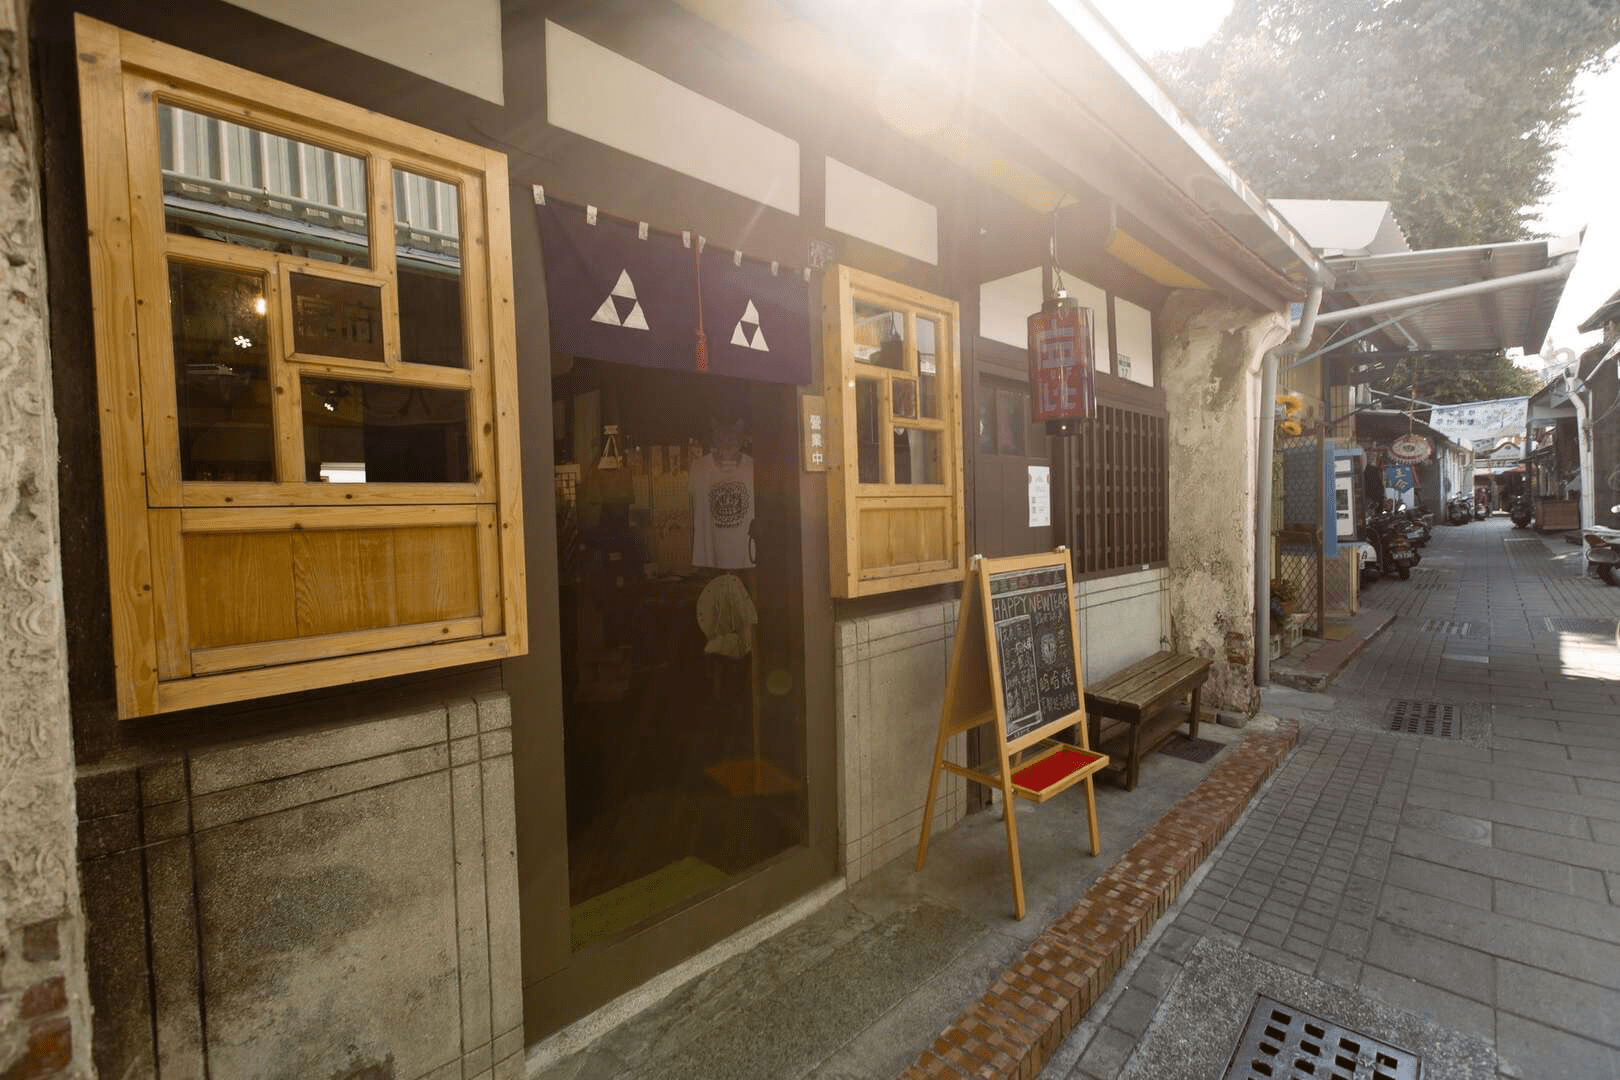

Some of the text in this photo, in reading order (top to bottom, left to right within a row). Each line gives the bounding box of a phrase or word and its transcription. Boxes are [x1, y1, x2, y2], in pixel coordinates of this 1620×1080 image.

[809, 415, 823, 464] 營業中
[994, 595, 1027, 620] HAPPY
